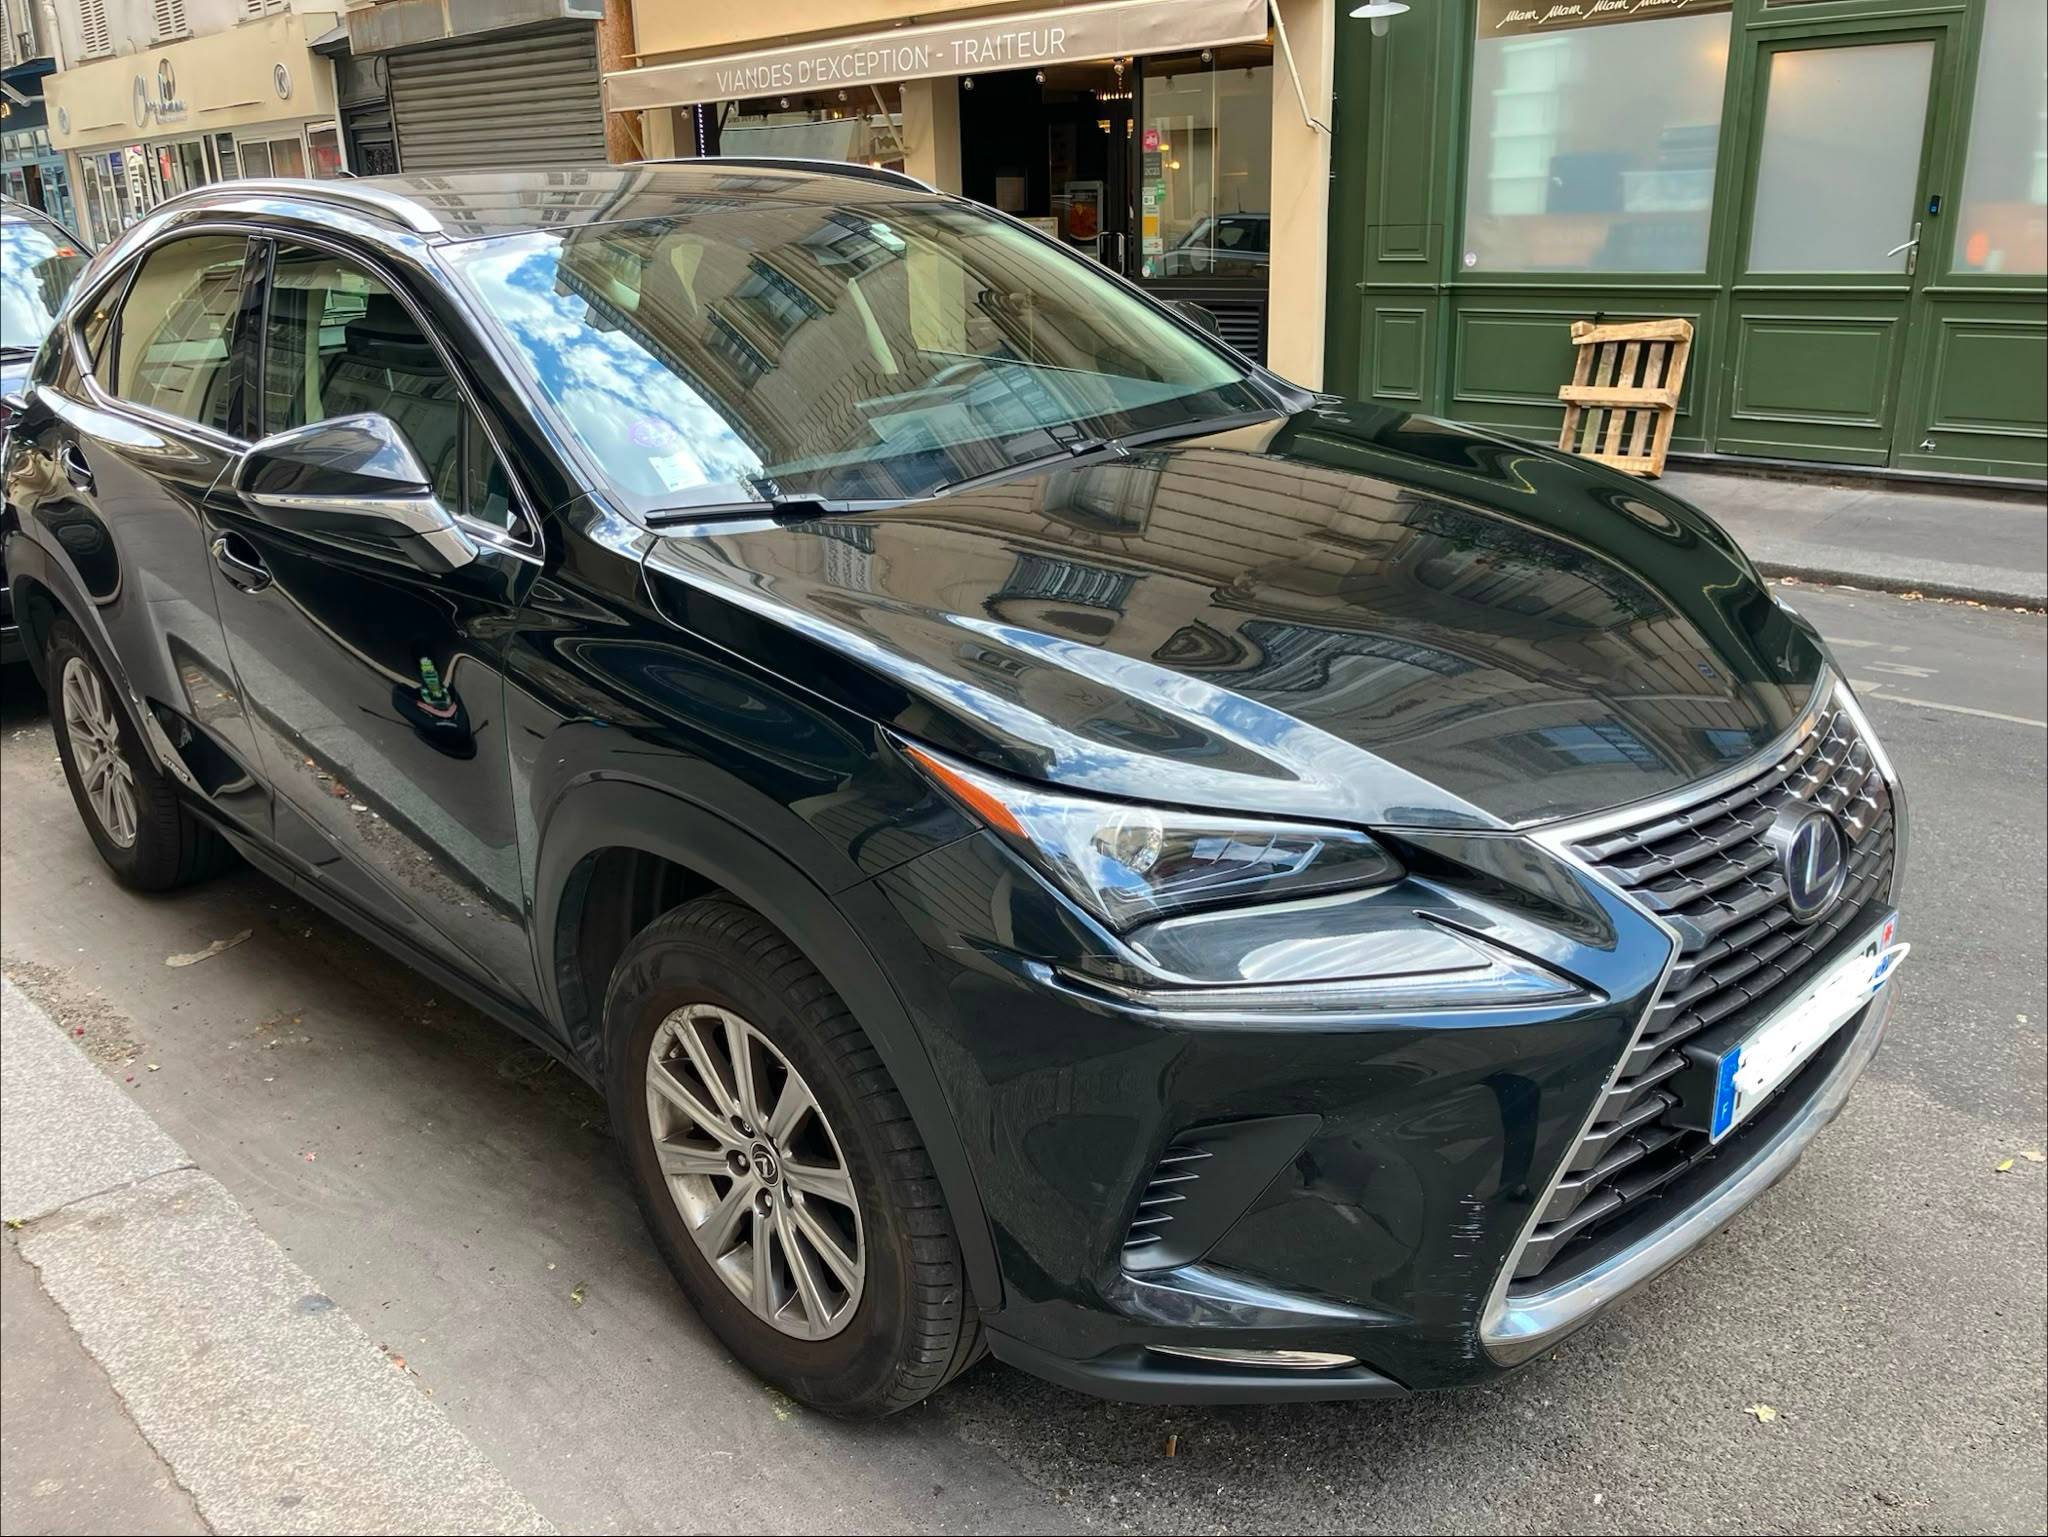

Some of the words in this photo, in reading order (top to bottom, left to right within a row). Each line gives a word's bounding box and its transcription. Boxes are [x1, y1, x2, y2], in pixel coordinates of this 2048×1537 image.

[716, 64, 793, 93] VIANDES
[798, 44, 929, 84] D'EXCEPTION
[951, 28, 1066, 65] TRAITEUR
[1721, 1101, 1729, 1121] F
